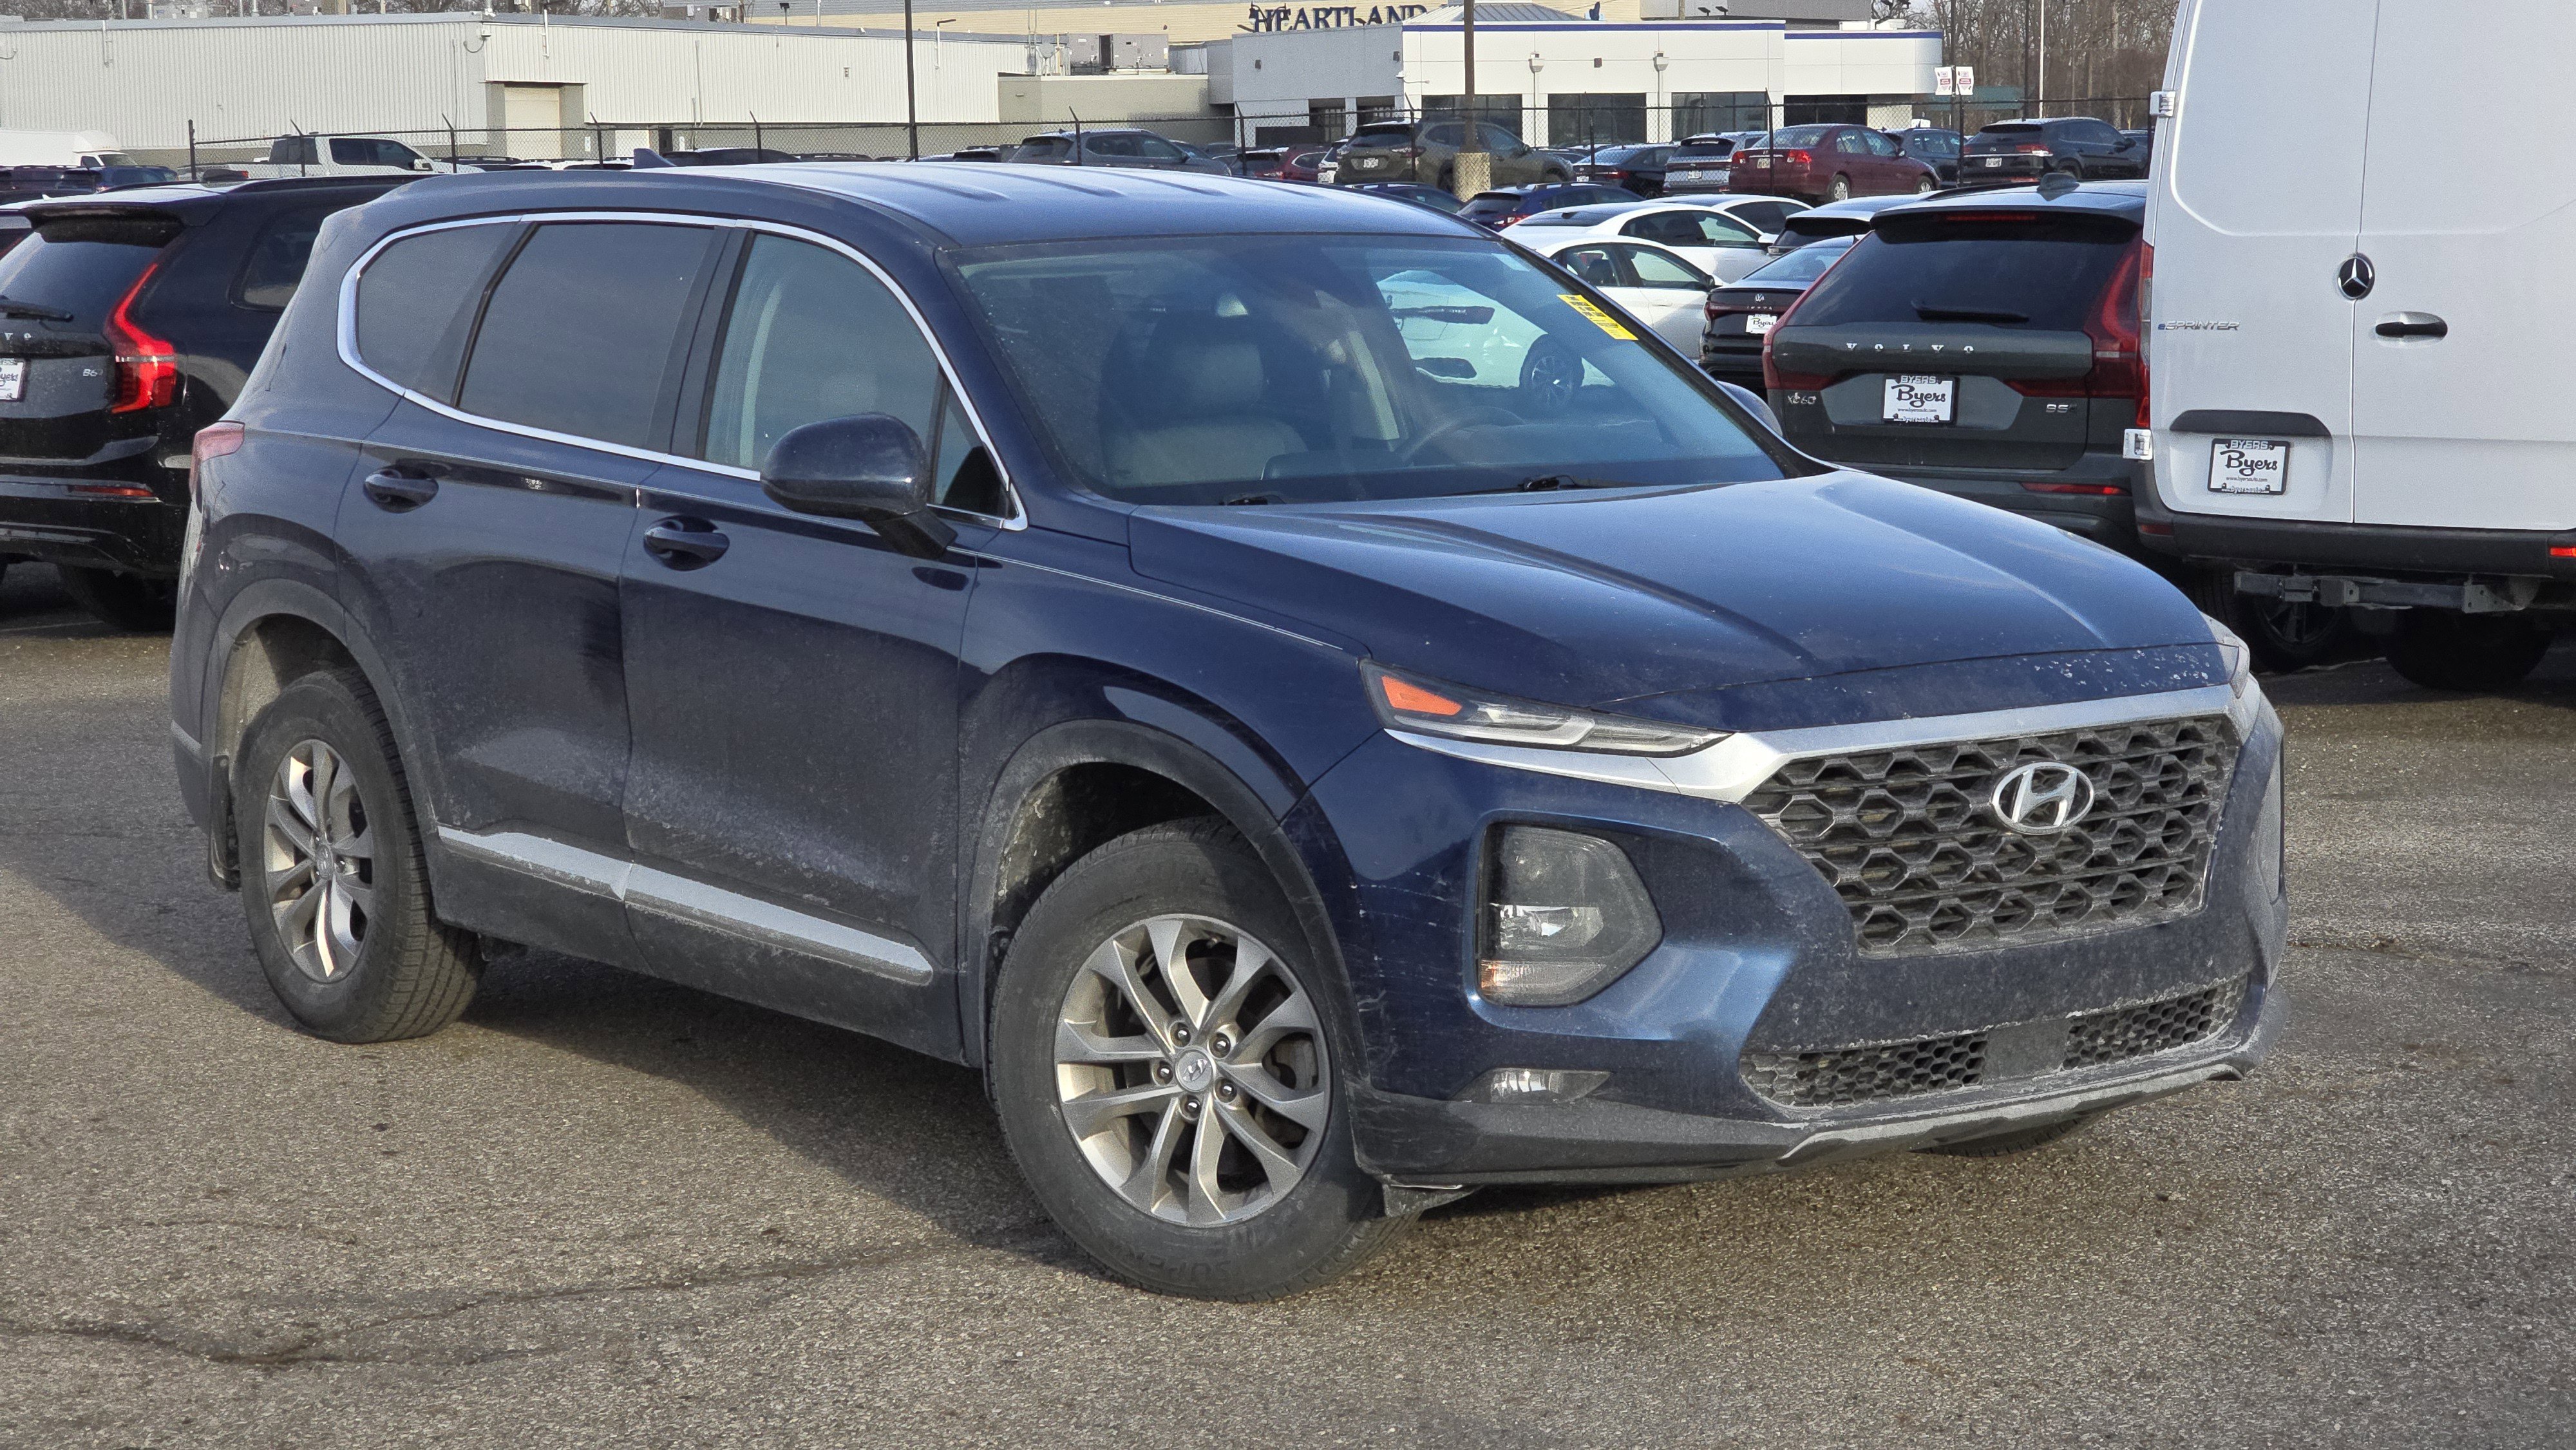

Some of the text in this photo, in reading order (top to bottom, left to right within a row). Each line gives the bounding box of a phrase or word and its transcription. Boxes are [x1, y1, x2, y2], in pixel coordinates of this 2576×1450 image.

[1254, 5, 1428, 32] HEARTLAND
[2157, 320, 2240, 330] eSPRINTER
[1846, 343, 1974, 353] VOLVO
[1900, 375, 1937, 384] BYERS
[1891, 384, 1946, 408] Byers
[2230, 440, 2269, 450] BYERS
[2219, 450, 2278, 476] Byers
